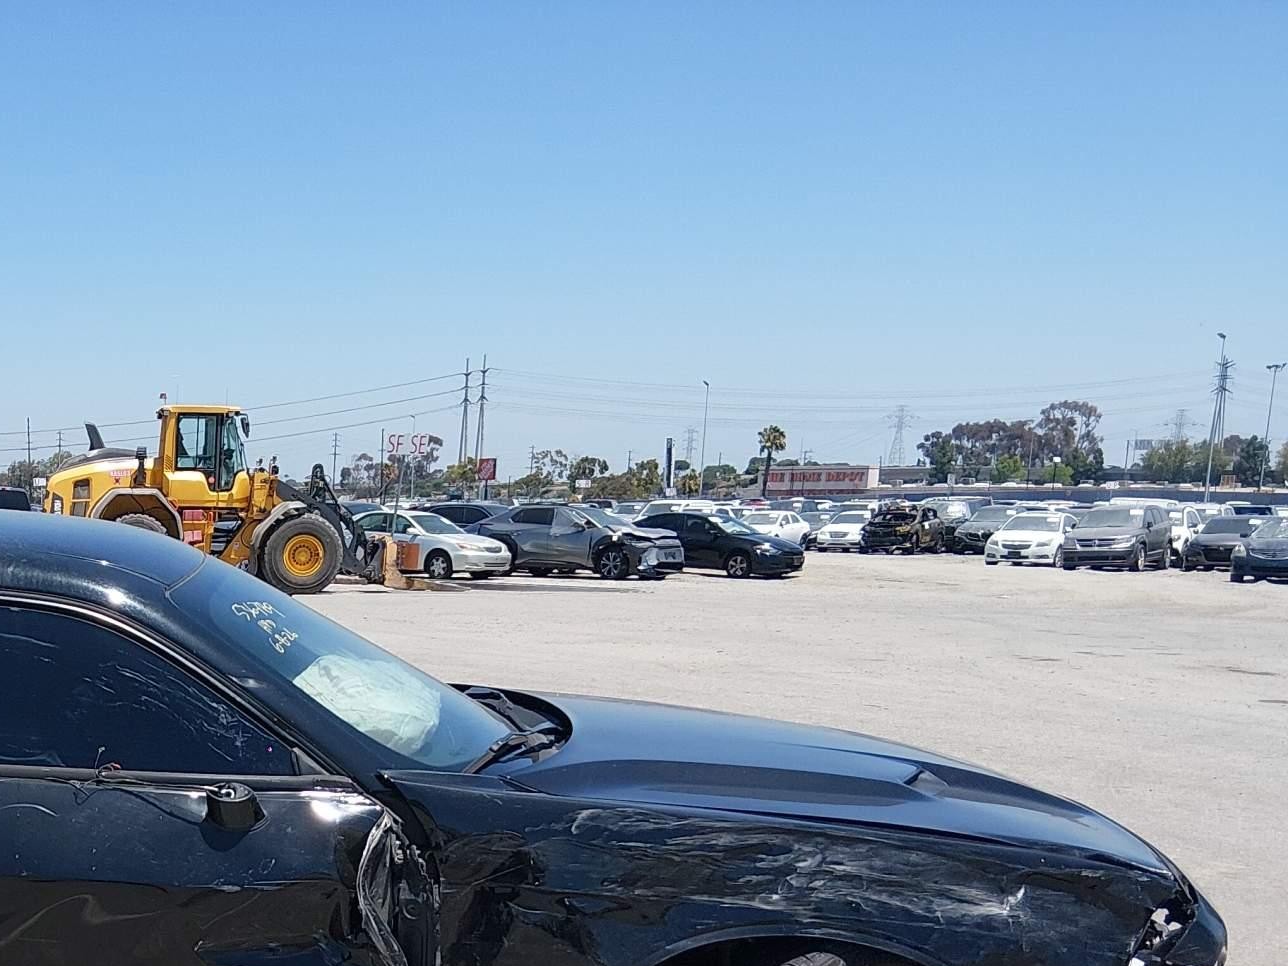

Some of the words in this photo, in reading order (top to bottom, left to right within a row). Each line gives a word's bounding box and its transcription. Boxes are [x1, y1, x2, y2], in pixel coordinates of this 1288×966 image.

[386, 433, 405, 453] SF
[409, 434, 427, 455] SE
[826, 471, 866, 482] DEPOT
